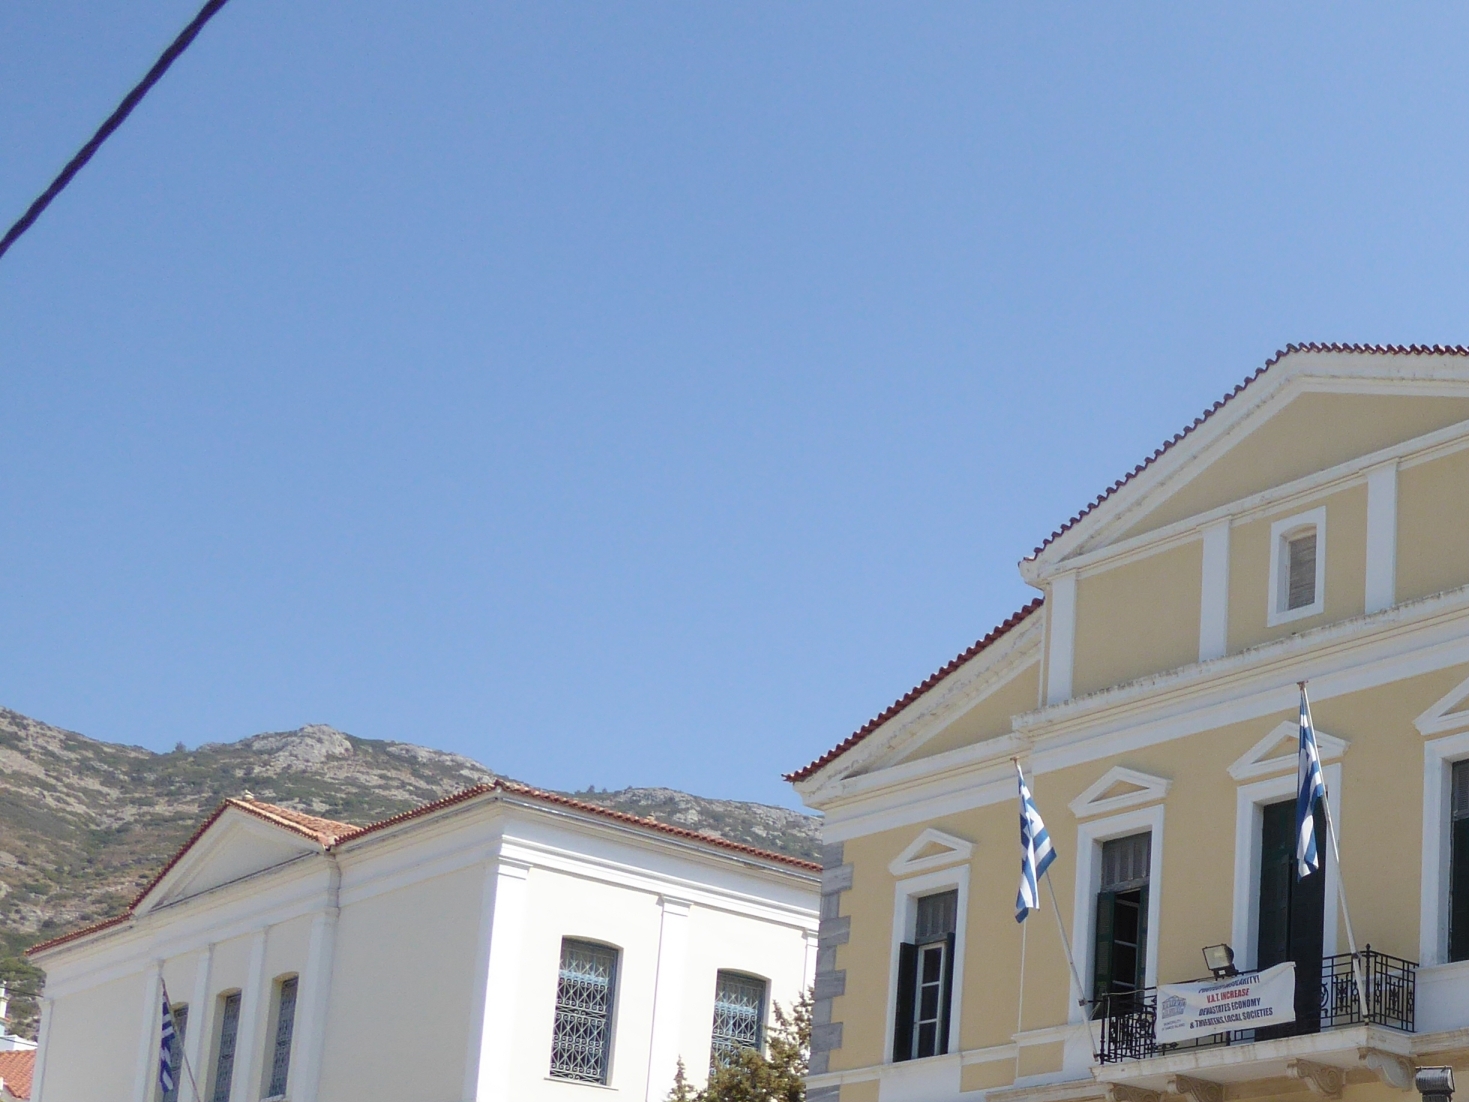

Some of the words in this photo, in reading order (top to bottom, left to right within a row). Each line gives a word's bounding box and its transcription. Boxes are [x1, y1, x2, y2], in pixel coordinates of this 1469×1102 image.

[1220, 988, 1250, 1001] INCREASE
[1198, 1002, 1231, 1017] DEVASTATES
[1231, 997, 1261, 1012] ECONOMY
[1189, 1021, 1195, 1029] &
[1224, 1013, 1243, 1024] LOCAL
[1242, 1007, 1274, 1021] SOCIETIES
